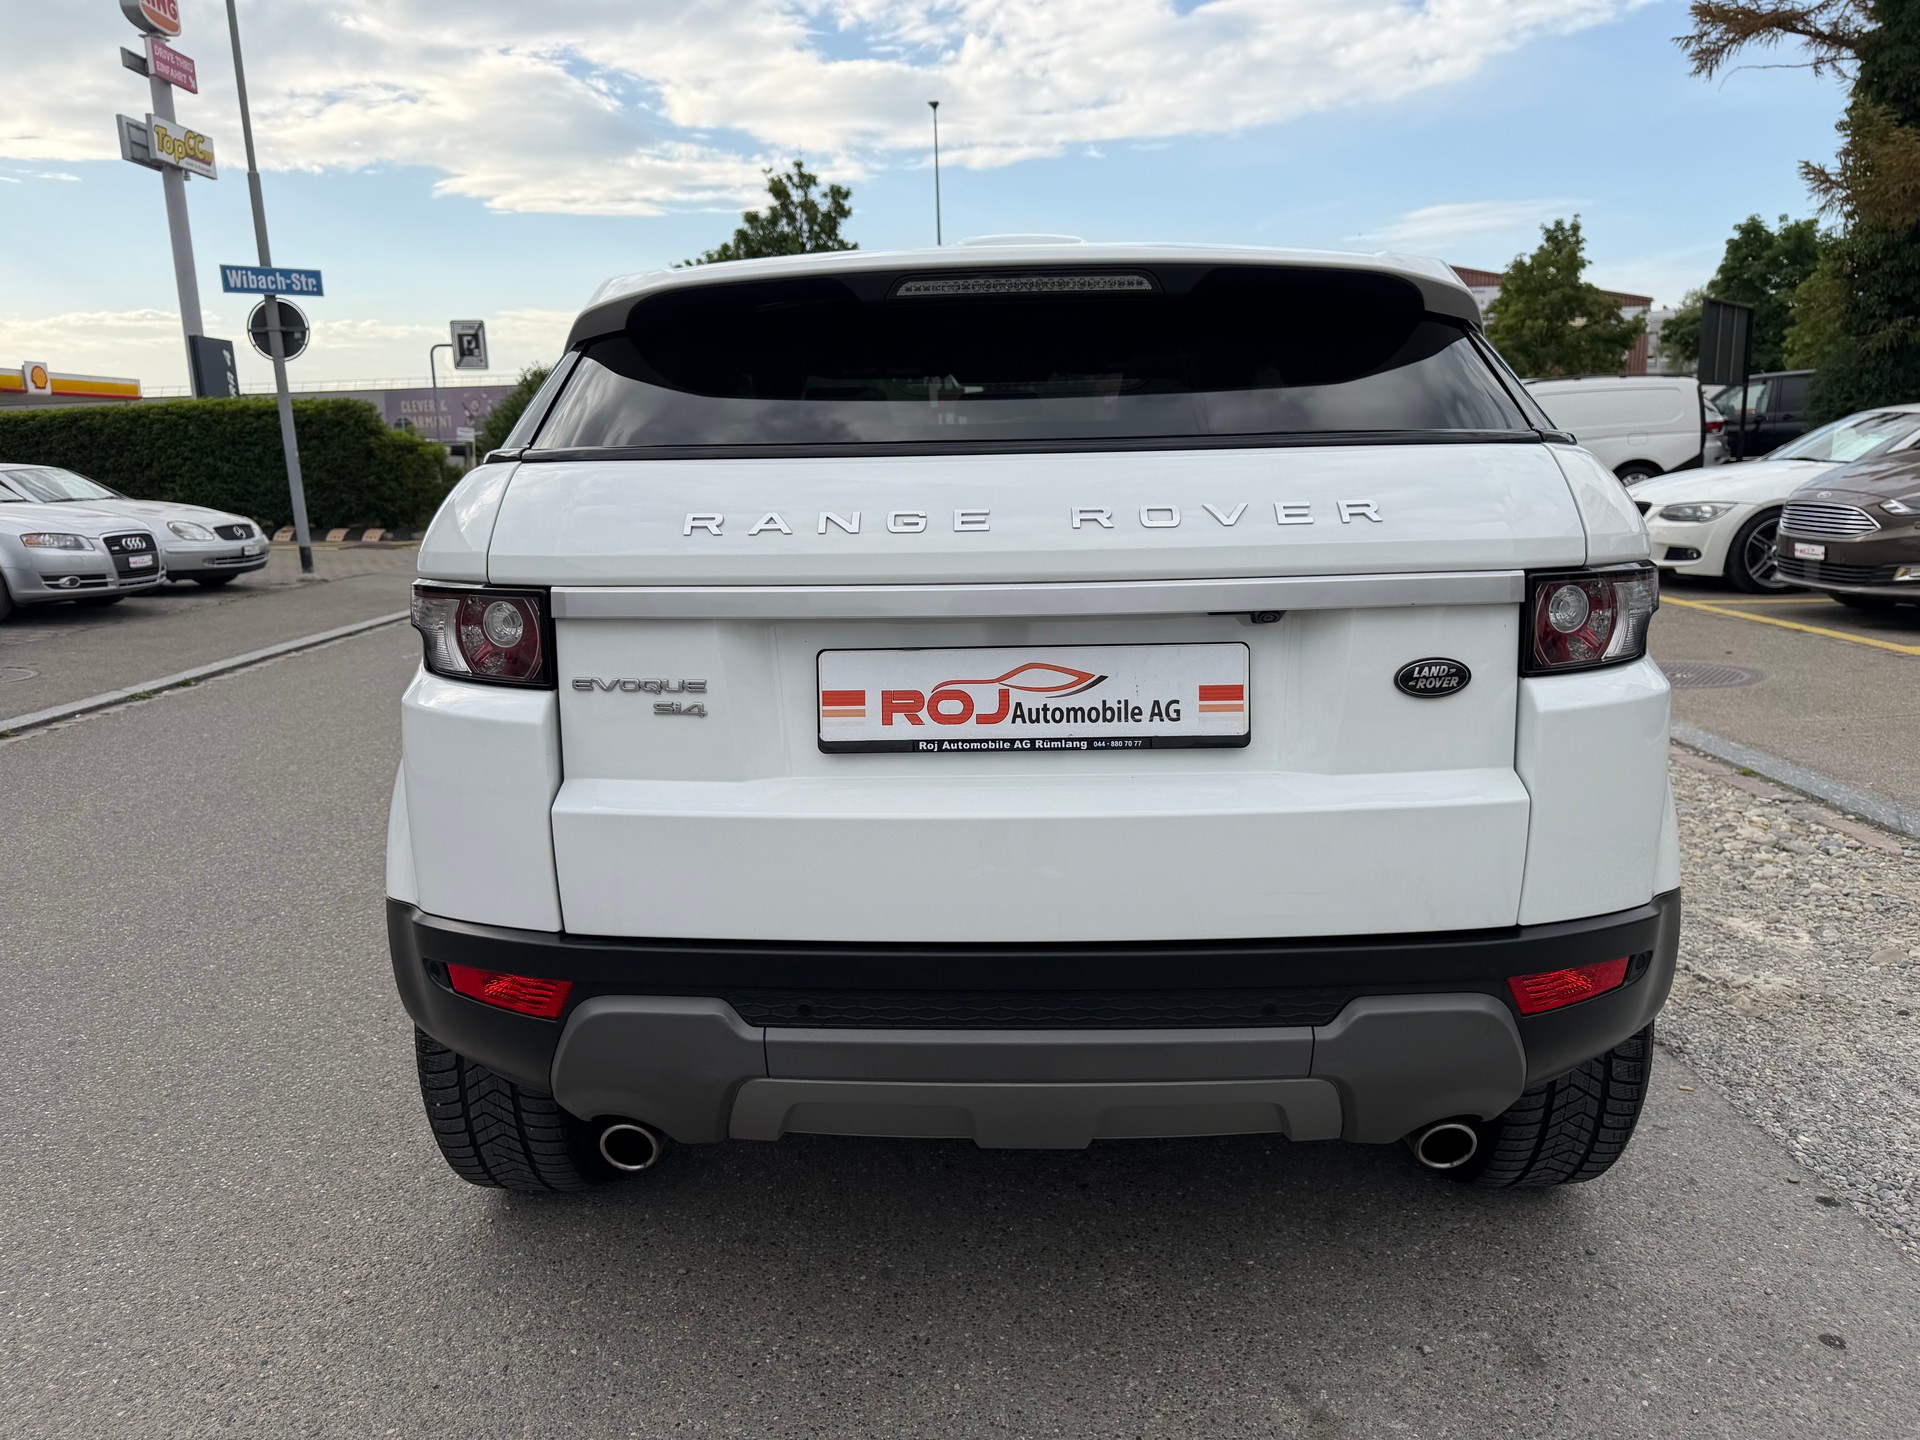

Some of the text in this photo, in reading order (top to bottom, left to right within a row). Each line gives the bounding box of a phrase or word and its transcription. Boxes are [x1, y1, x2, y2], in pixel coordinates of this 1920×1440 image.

[143, 0, 178, 20] NG
[153, 44, 175, 64] DRIVE
[154, 124, 205, 165] TopCC
[226, 269, 318, 292] Wibach-Str.
[683, 498, 1384, 537] RANGE ROVER
[571, 676, 708, 696] EVOQUE
[1412, 665, 1460, 690] LAND ROVER
[881, 688, 1010, 726] ROJ
[1011, 698, 1182, 725] Automobile AG
[919, 741, 938, 752] Roj
[942, 740, 1011, 750] Automobile
[1013, 739, 1032, 749] AG
[1035, 739, 1088, 750] Rümlang
[1093, 740, 1106, 748] 044
[1110, 740, 1123, 748] 880
